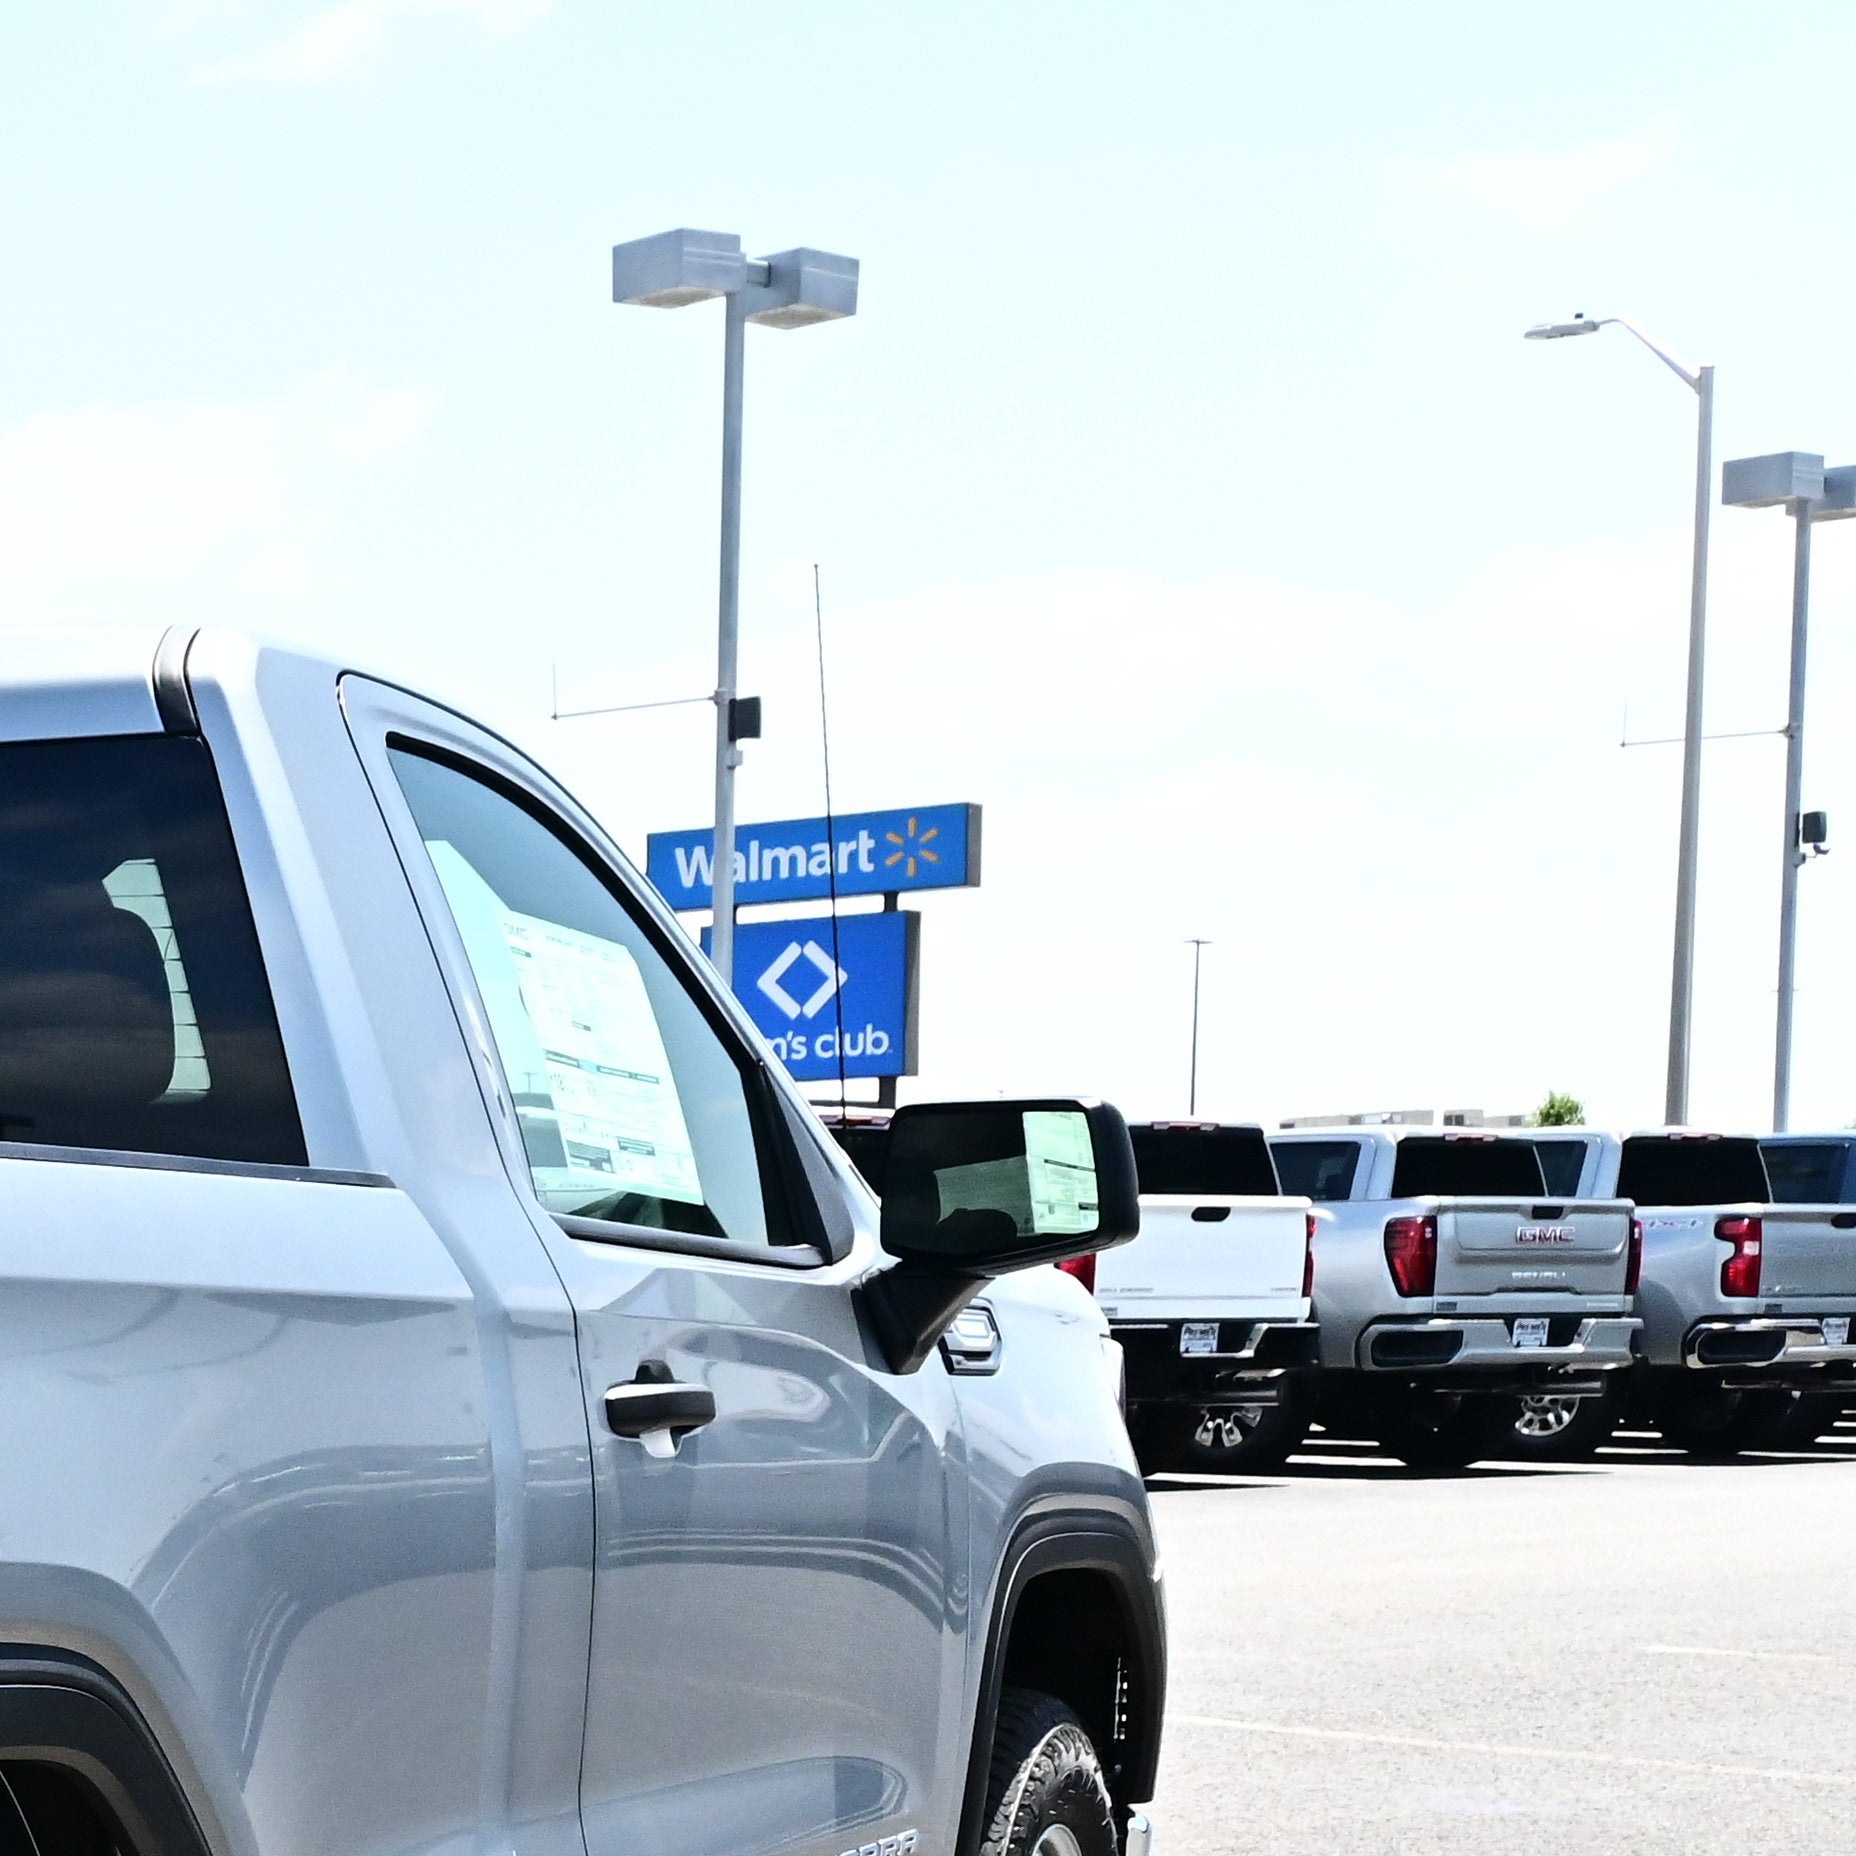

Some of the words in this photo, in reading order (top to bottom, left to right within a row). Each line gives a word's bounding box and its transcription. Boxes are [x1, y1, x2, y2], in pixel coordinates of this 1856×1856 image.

[674, 829, 875, 888] Walmart
[814, 1023, 889, 1058] club
[1515, 1226, 1576, 1245] GMC
